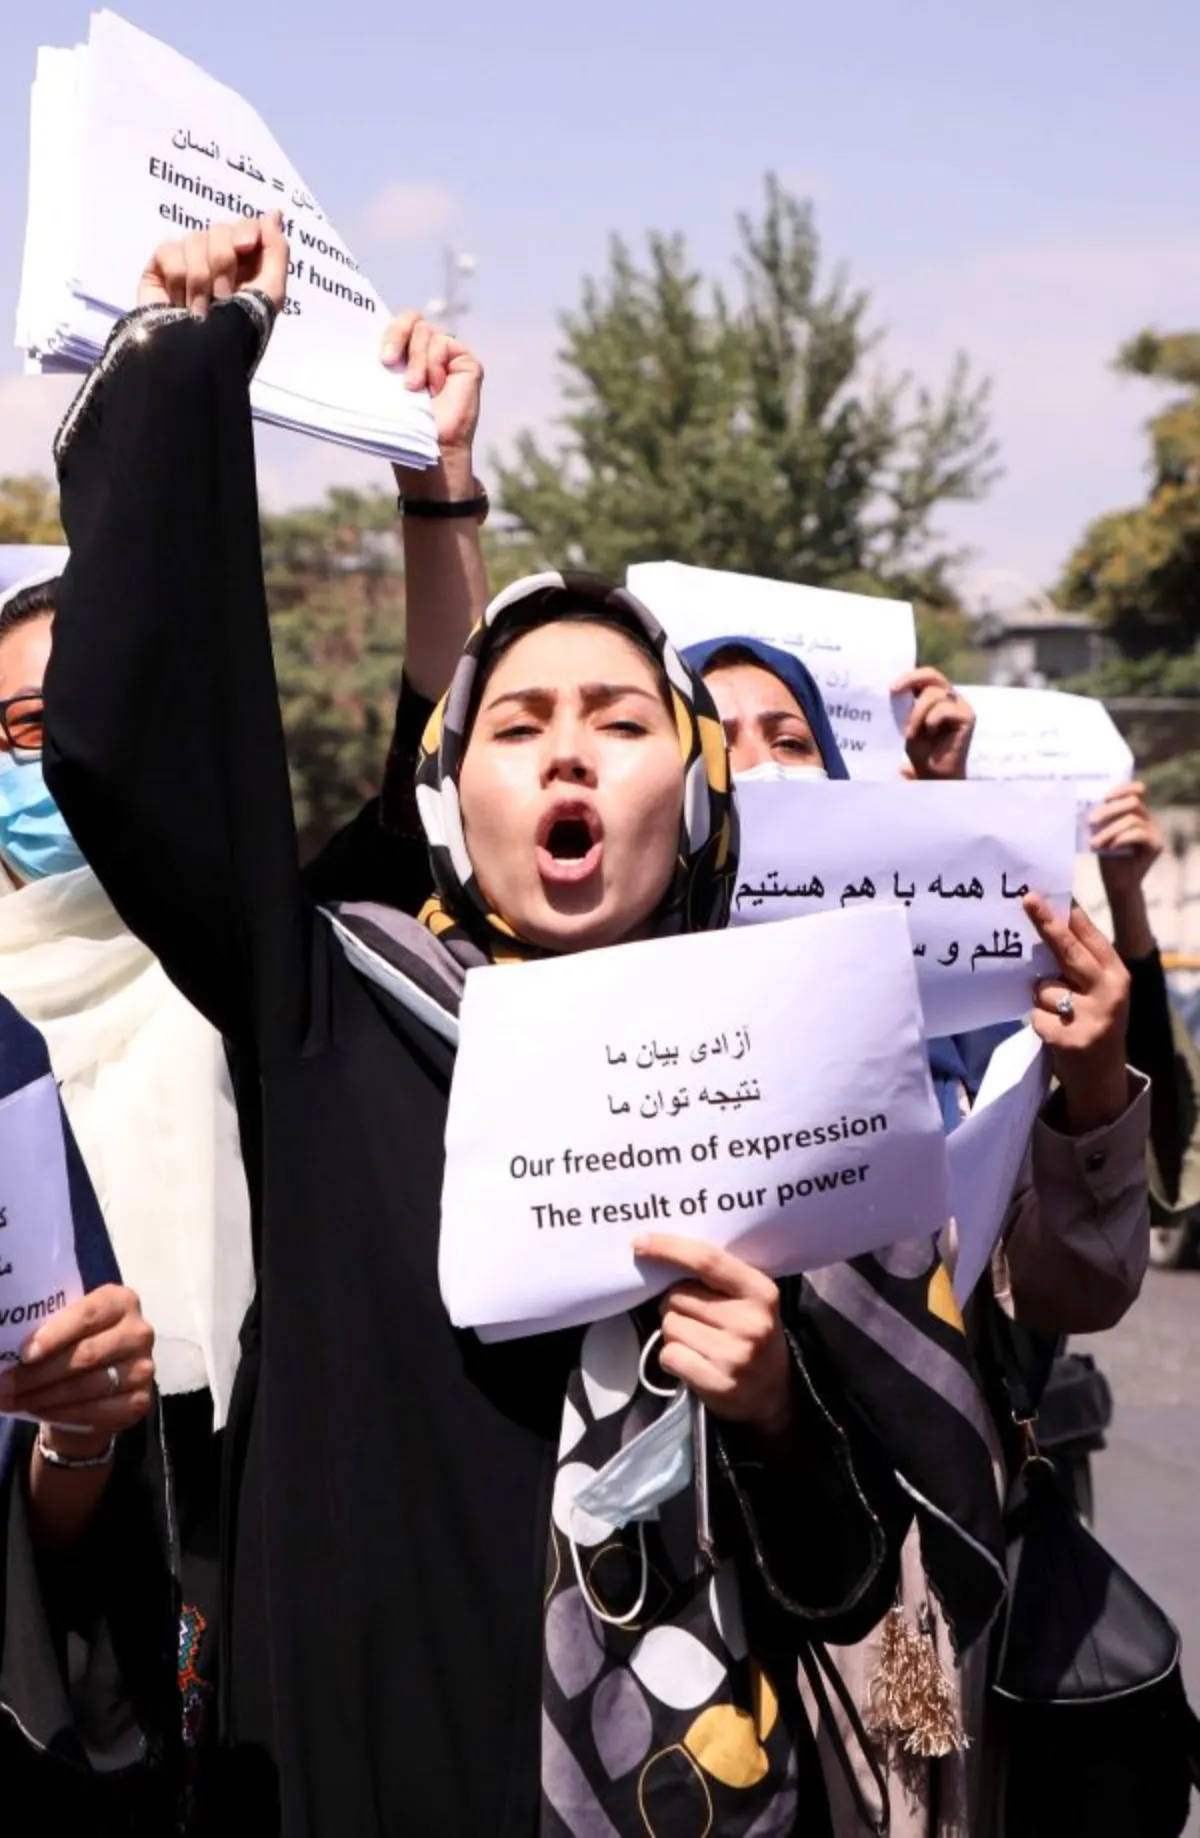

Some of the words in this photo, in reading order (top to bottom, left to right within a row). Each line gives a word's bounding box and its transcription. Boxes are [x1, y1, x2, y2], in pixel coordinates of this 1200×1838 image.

[171, 128, 221, 160] انسان
[226, 154, 266, 183] حذف
[308, 263, 377, 313] human
[735, 871, 825, 911] هستیم
[840, 875, 876, 908] هم
[893, 871, 915, 906] با
[928, 873, 985, 899] همه
[1001, 872, 1029, 899] ما
[937, 941, 960, 966] و
[971, 928, 1023, 972] ظلم
[605, 1045, 627, 1065] ما
[636, 1040, 679, 1069] بیان
[607, 1094, 631, 1115] ما
[640, 1087, 690, 1118] توان
[698, 1079, 761, 1111] نتیجه
[509, 1154, 555, 1180] Our
[563, 1135, 681, 1174] freedom
[691, 1135, 719, 1163] of
[728, 1111, 889, 1162] expression
[531, 1204, 582, 1230] The
[591, 1193, 671, 1225] result
[680, 1189, 708, 1217] of
[717, 1185, 768, 1213] our
[776, 1162, 870, 1206] power
